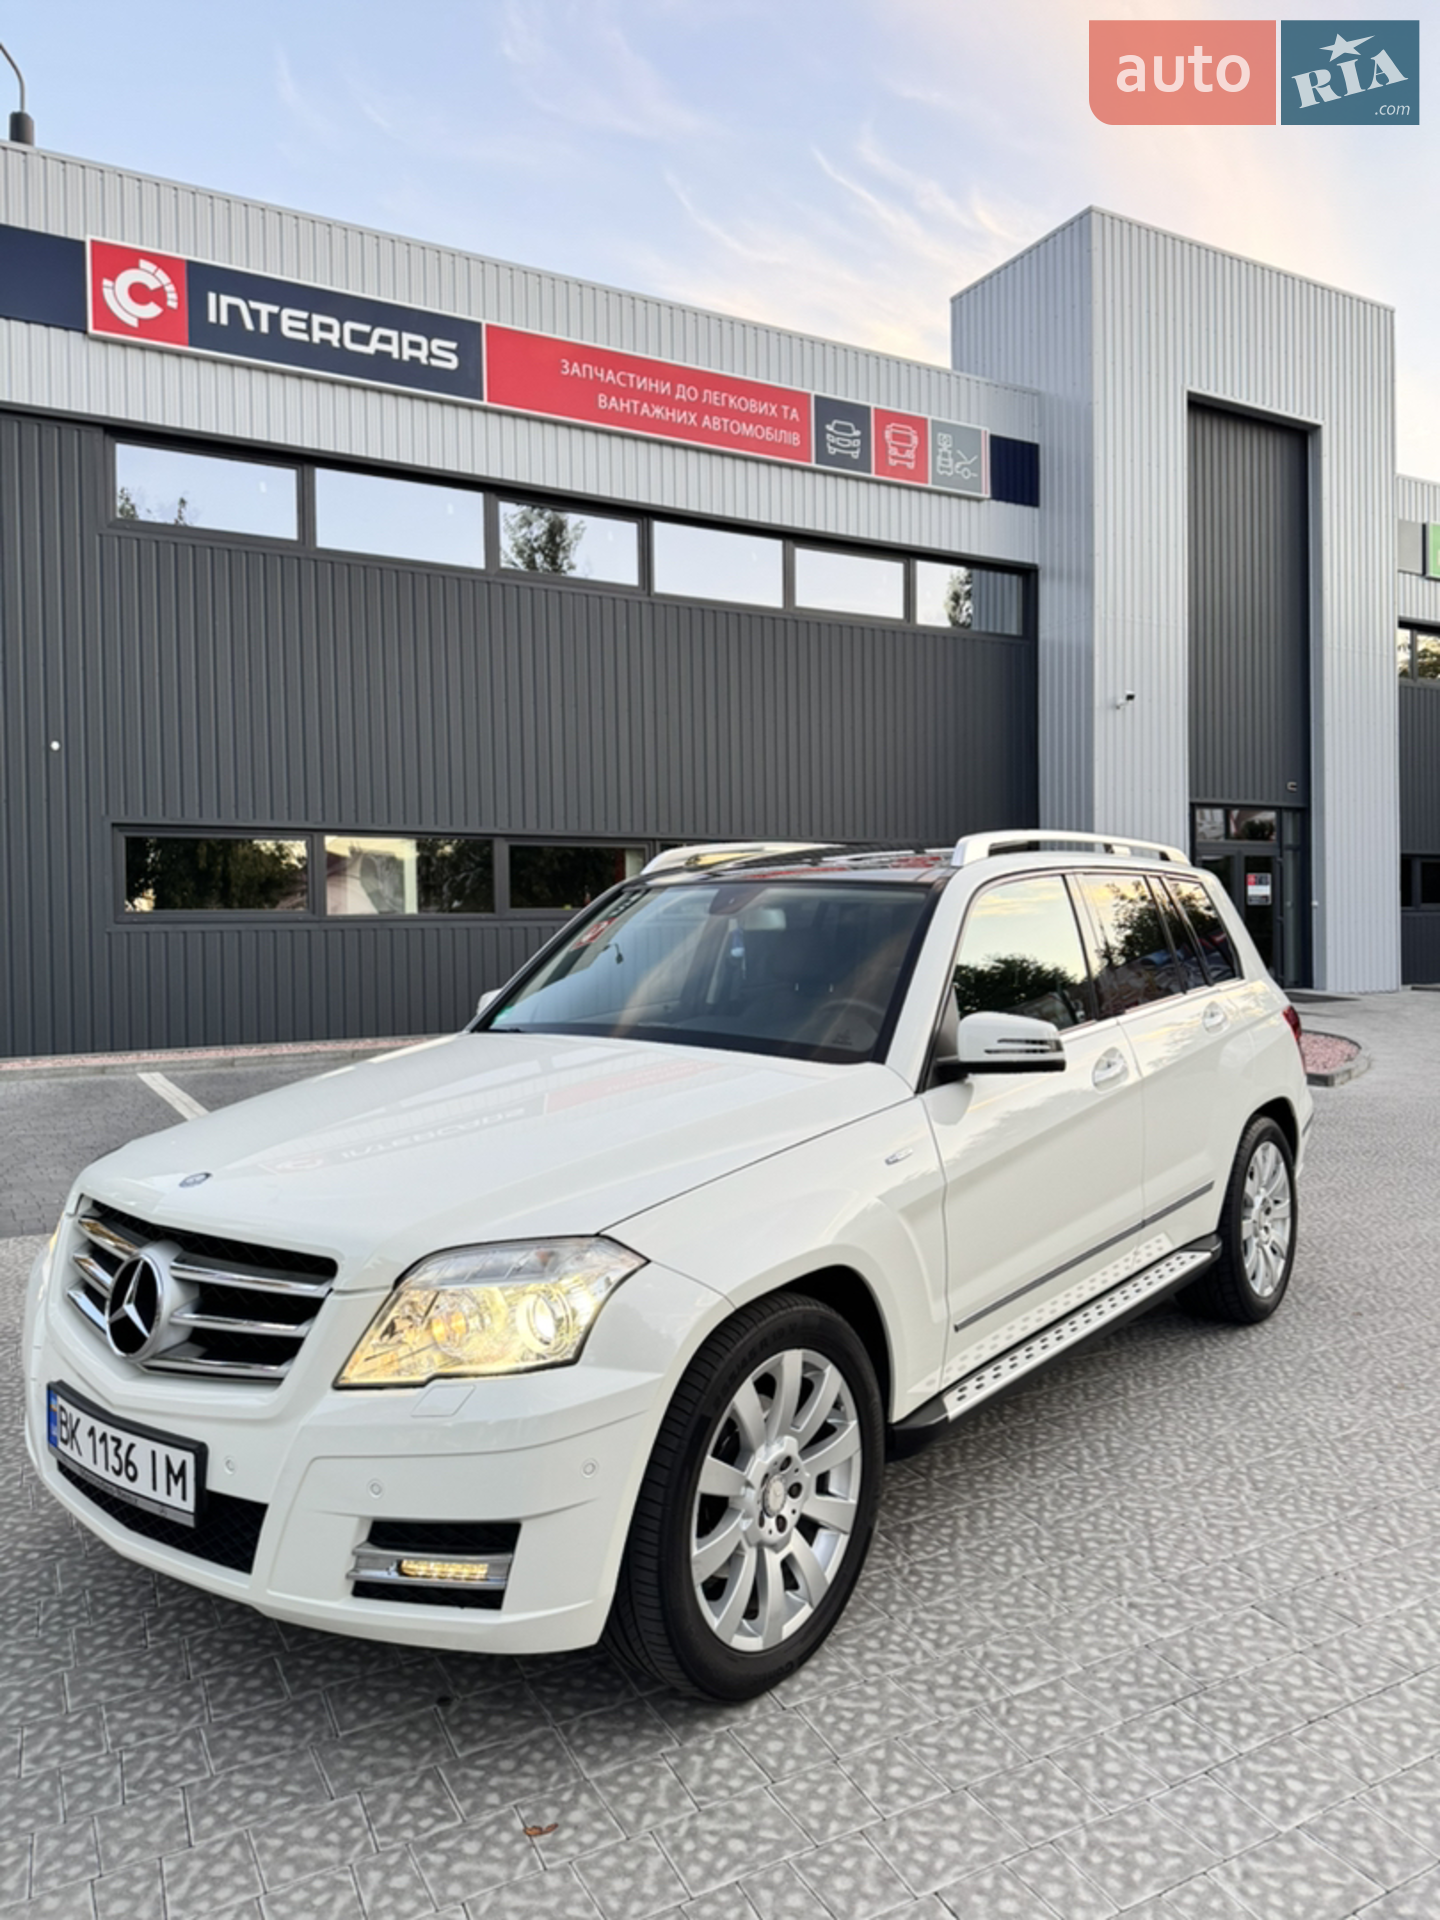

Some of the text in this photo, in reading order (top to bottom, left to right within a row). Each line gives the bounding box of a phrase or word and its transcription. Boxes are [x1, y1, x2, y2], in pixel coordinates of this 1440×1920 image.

[207, 291, 459, 371] INTERCARS
[560, 358, 801, 423] ЗАПЧАСТИНИ ДО ЛЕГКОВИХ ТА
[597, 393, 801, 448] ВАНТАЖНИХ АВТОМОБІЛІВ
[59, 1404, 82, 1457] BK
[87, 1425, 138, 1483] 1136
[151, 1449, 187, 1502] IM
